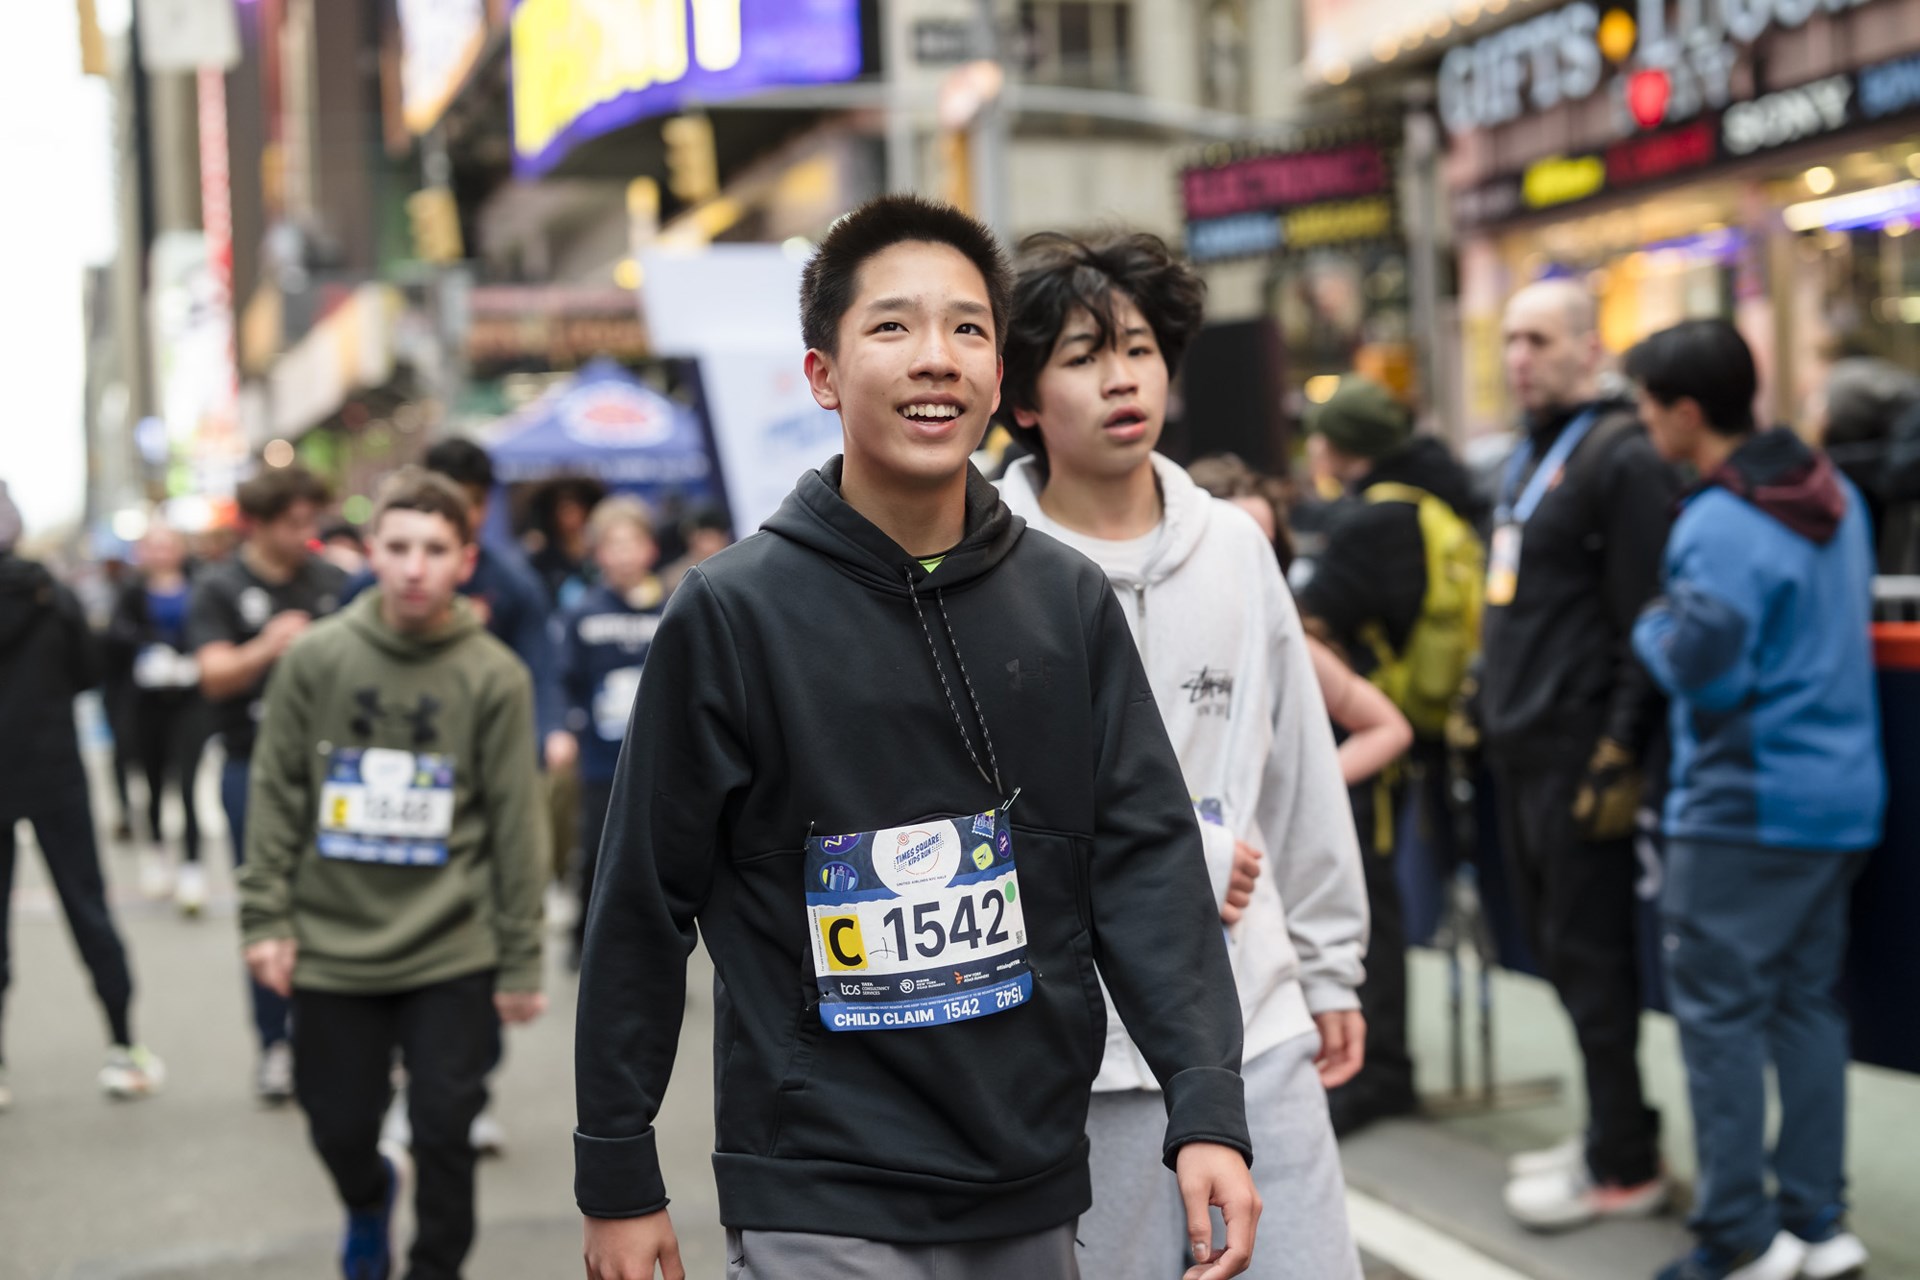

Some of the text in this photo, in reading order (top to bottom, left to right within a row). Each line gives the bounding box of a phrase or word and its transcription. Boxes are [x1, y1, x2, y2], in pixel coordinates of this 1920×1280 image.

[1437, 2, 1601, 134] GIFTS
[1722, 76, 1853, 155] SONY
[895, 833, 940, 864] TIMES SQUARE
[908, 848, 931, 866] KIDS RUN
[829, 918, 863, 967] C
[883, 888, 1009, 962] 1542
[840, 982, 861, 996] tcs
[996, 985, 1024, 1008] 1542
[834, 998, 980, 1026] CHILD CLAIM 1542
